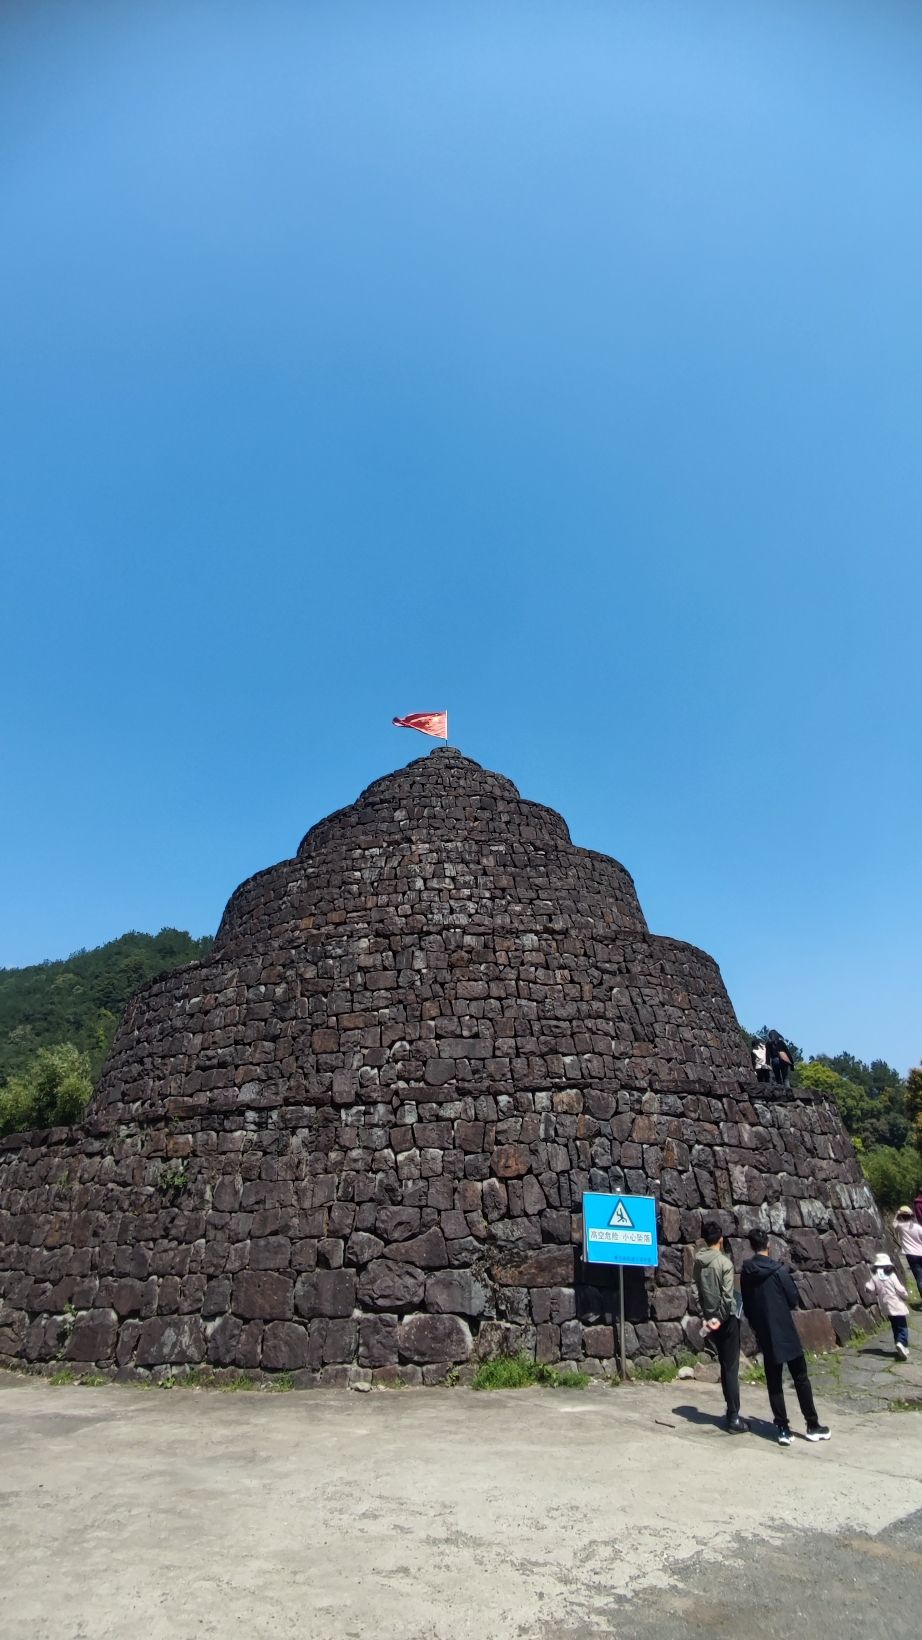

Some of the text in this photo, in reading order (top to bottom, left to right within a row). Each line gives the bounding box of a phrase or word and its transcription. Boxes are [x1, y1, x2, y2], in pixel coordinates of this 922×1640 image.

[590, 1230, 651, 1243] 高空危险 小心坠落
